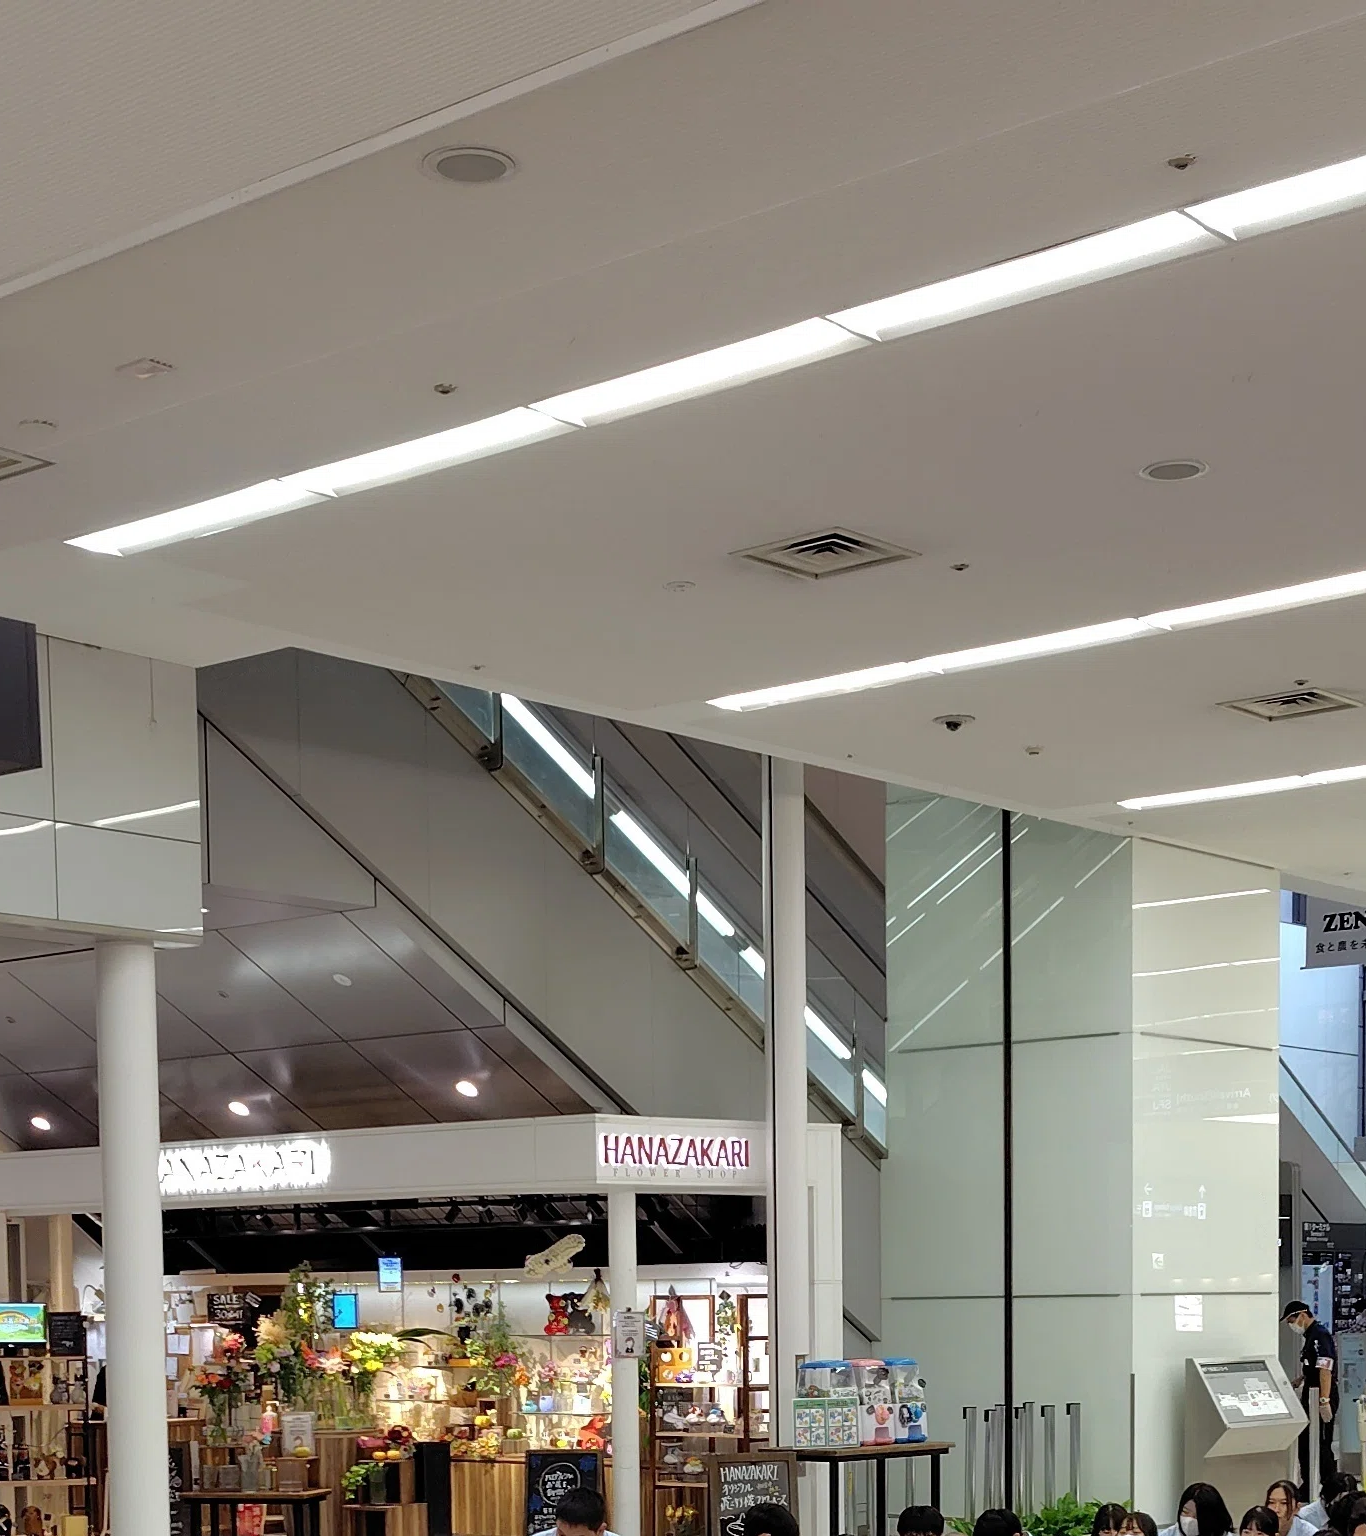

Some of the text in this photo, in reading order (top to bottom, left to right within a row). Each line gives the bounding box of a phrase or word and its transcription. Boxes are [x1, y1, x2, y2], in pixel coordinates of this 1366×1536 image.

[603, 1135, 750, 1167] HANAZAKARI
[613, 1168, 738, 1179] FLOWER SHOP
[213, 1294, 240, 1305] SALE
[719, 1464, 779, 1482] HANAZAKARI
